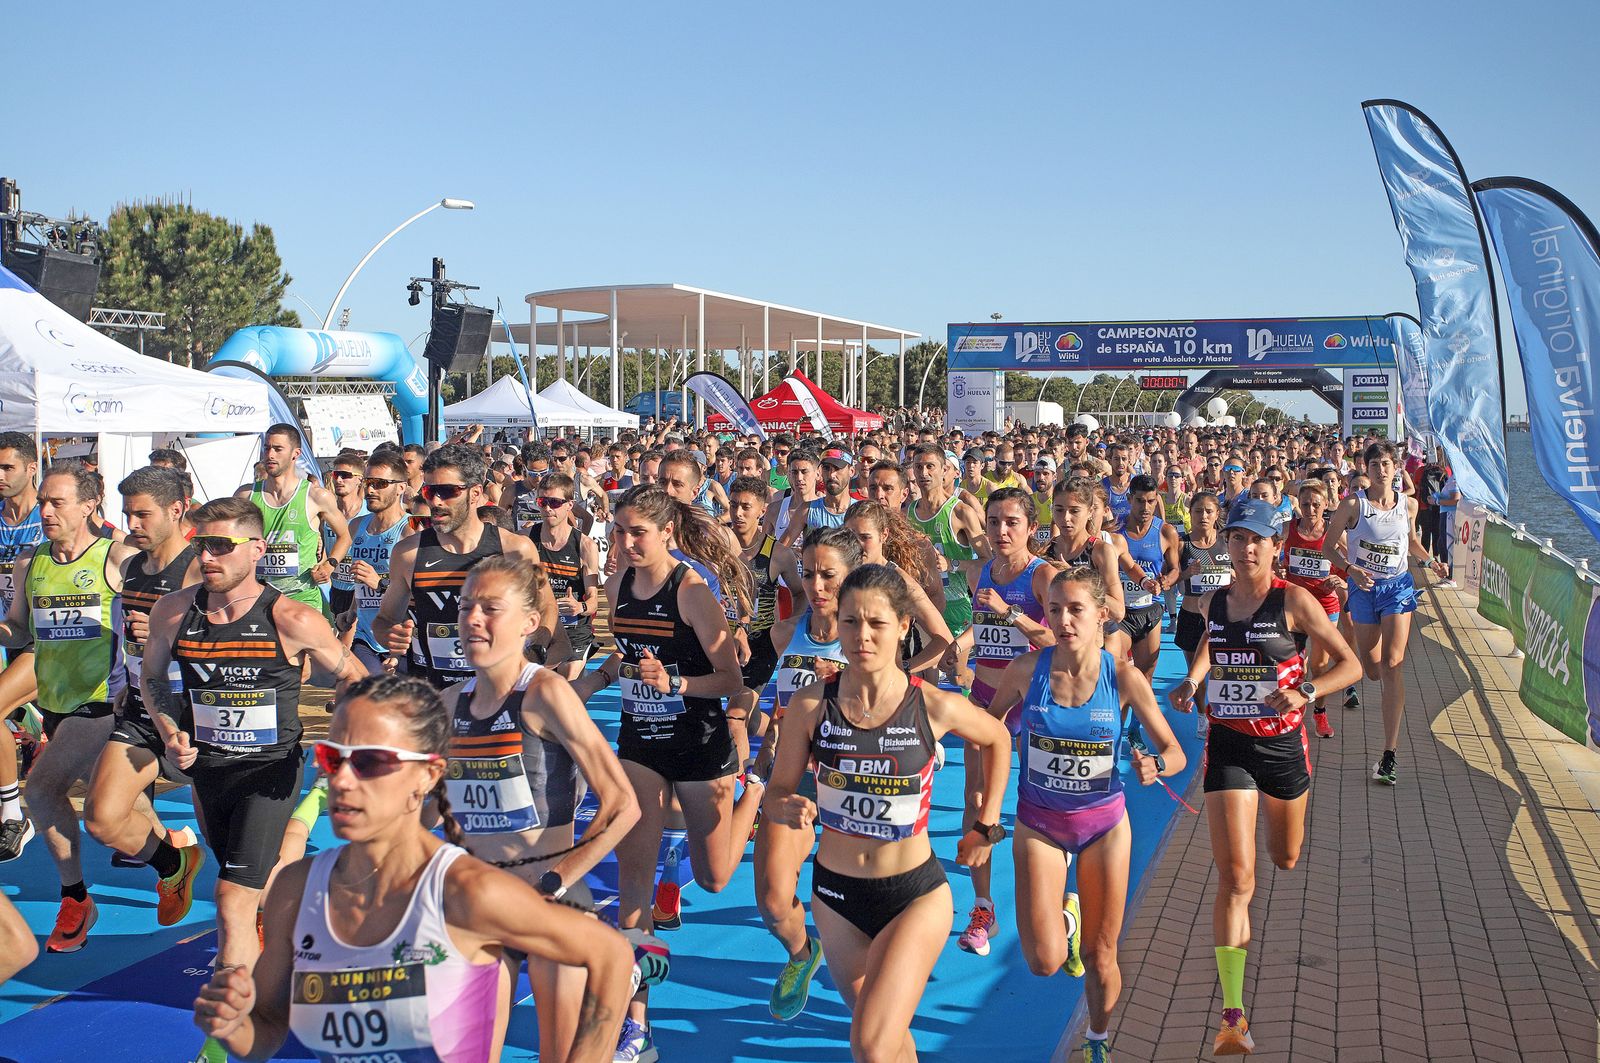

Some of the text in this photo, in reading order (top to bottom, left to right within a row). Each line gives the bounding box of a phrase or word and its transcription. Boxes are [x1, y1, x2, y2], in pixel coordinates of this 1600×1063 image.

[1097, 326, 1197, 339] CAMPEONATO
[1096, 338, 1233, 355] de ESPAÑA 10 km
[1272, 334, 1314, 347] HUELVA
[1350, 335, 1389, 347] WiHu
[337, 340, 372, 358] HUELVA
[1162, 355, 1196, 363] Absoluto
[1198, 356, 1203, 364] y
[353, 544, 389, 563] nerja
[1366, 552, 1389, 566] 404
[263, 555, 286, 566] 108
[1299, 558, 1320, 570] 493
[1200, 575, 1222, 585] 407
[49, 609, 83, 626] 172
[979, 627, 1011, 644] 403
[1230, 652, 1255, 665] BM
[219, 666, 262, 676] VICKY
[1218, 683, 1258, 702] 432
[218, 709, 246, 728] 37
[490, 722, 516, 732] adidas
[820, 720, 853, 738] Bilbao
[820, 740, 857, 751] Guedan
[884, 737, 921, 747] Bizkaialde
[1060, 740, 1104, 750] RUNNING
[466, 760, 508, 769] RUNNING
[860, 759, 891, 774] BM
[1046, 756, 1091, 778] 426
[477, 771, 501, 779] LOOP
[854, 775, 910, 787] RUNNING
[463, 784, 501, 810] 401
[867, 786, 900, 796] LOOP
[840, 795, 893, 822] 402
[330, 968, 408, 987] RUNNING
[347, 985, 392, 1002] LOOP
[321, 1009, 390, 1050] 409
